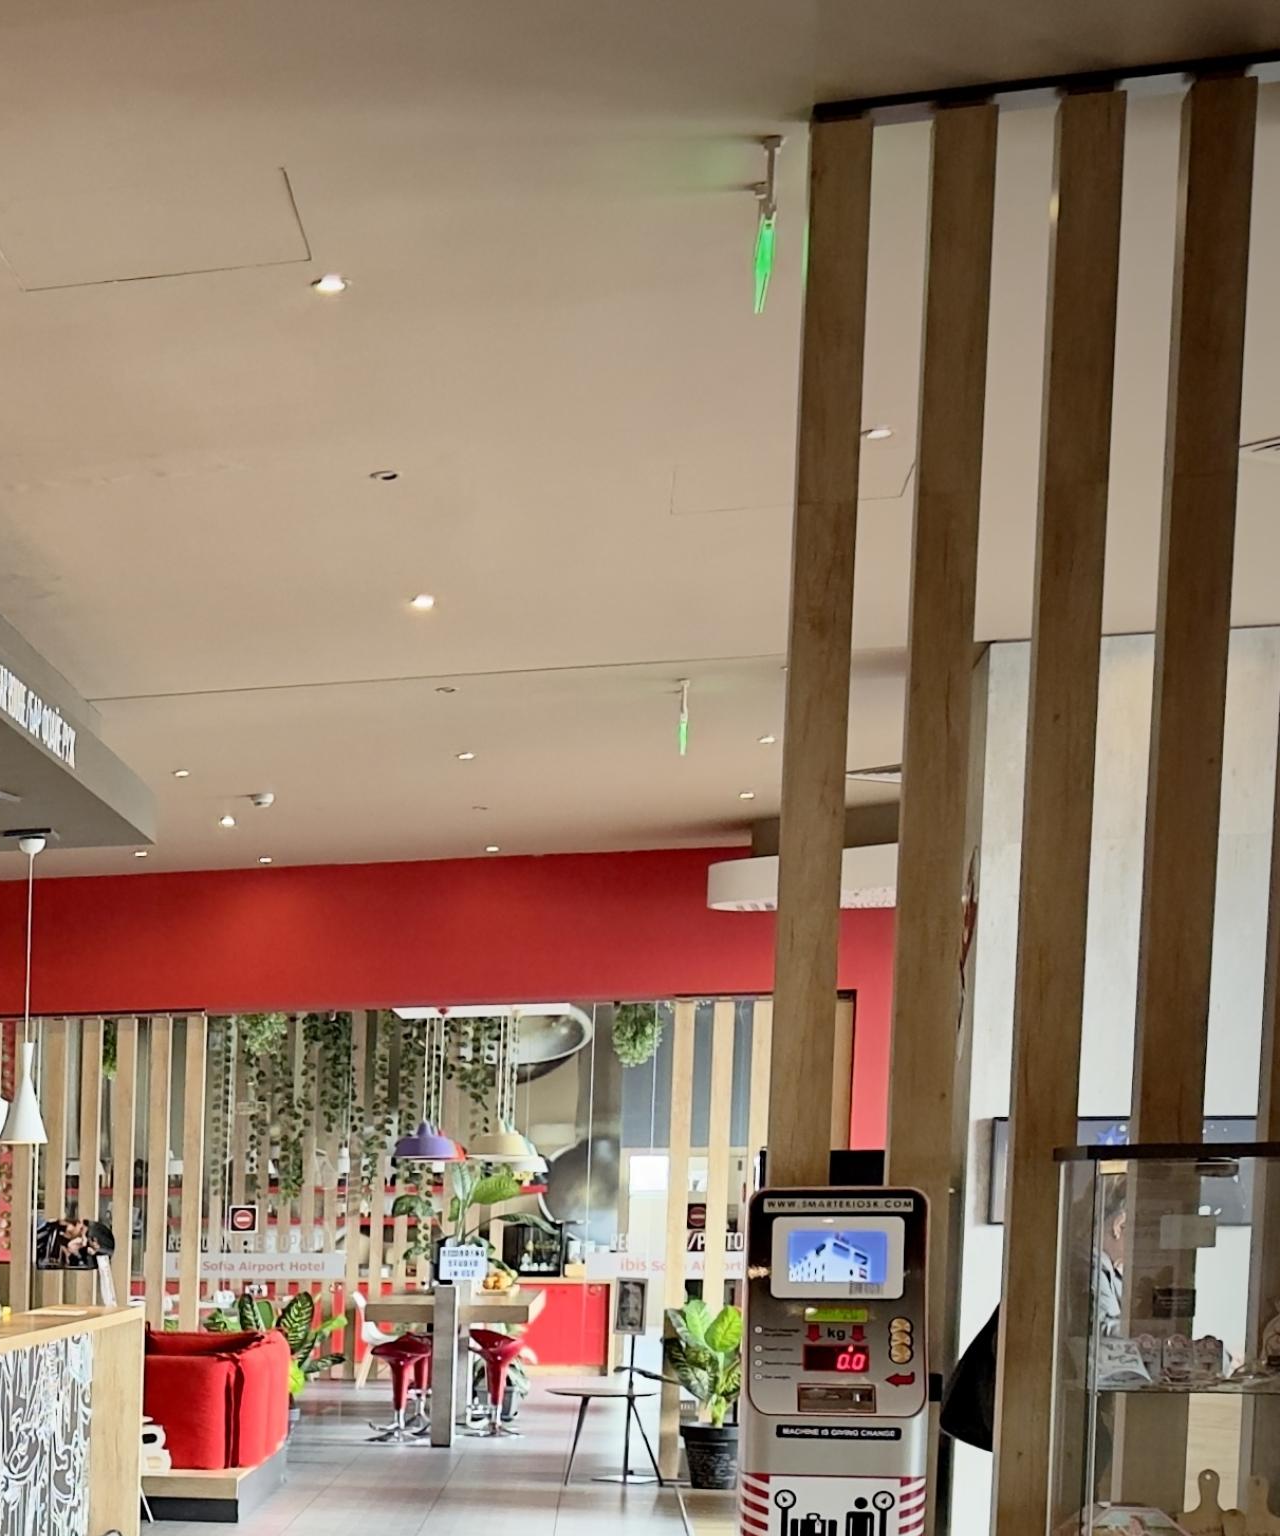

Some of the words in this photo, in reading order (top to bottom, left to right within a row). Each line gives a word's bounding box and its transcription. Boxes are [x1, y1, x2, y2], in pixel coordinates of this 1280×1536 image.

[203, 1260, 235, 1271] Sofia
[240, 1260, 285, 1273] Airport
[290, 1260, 325, 1271] Hotel
[621, 1258, 646, 1271] ibis
[827, 1327, 846, 1341] kg
[836, 1353, 866, 1370] 0.0
